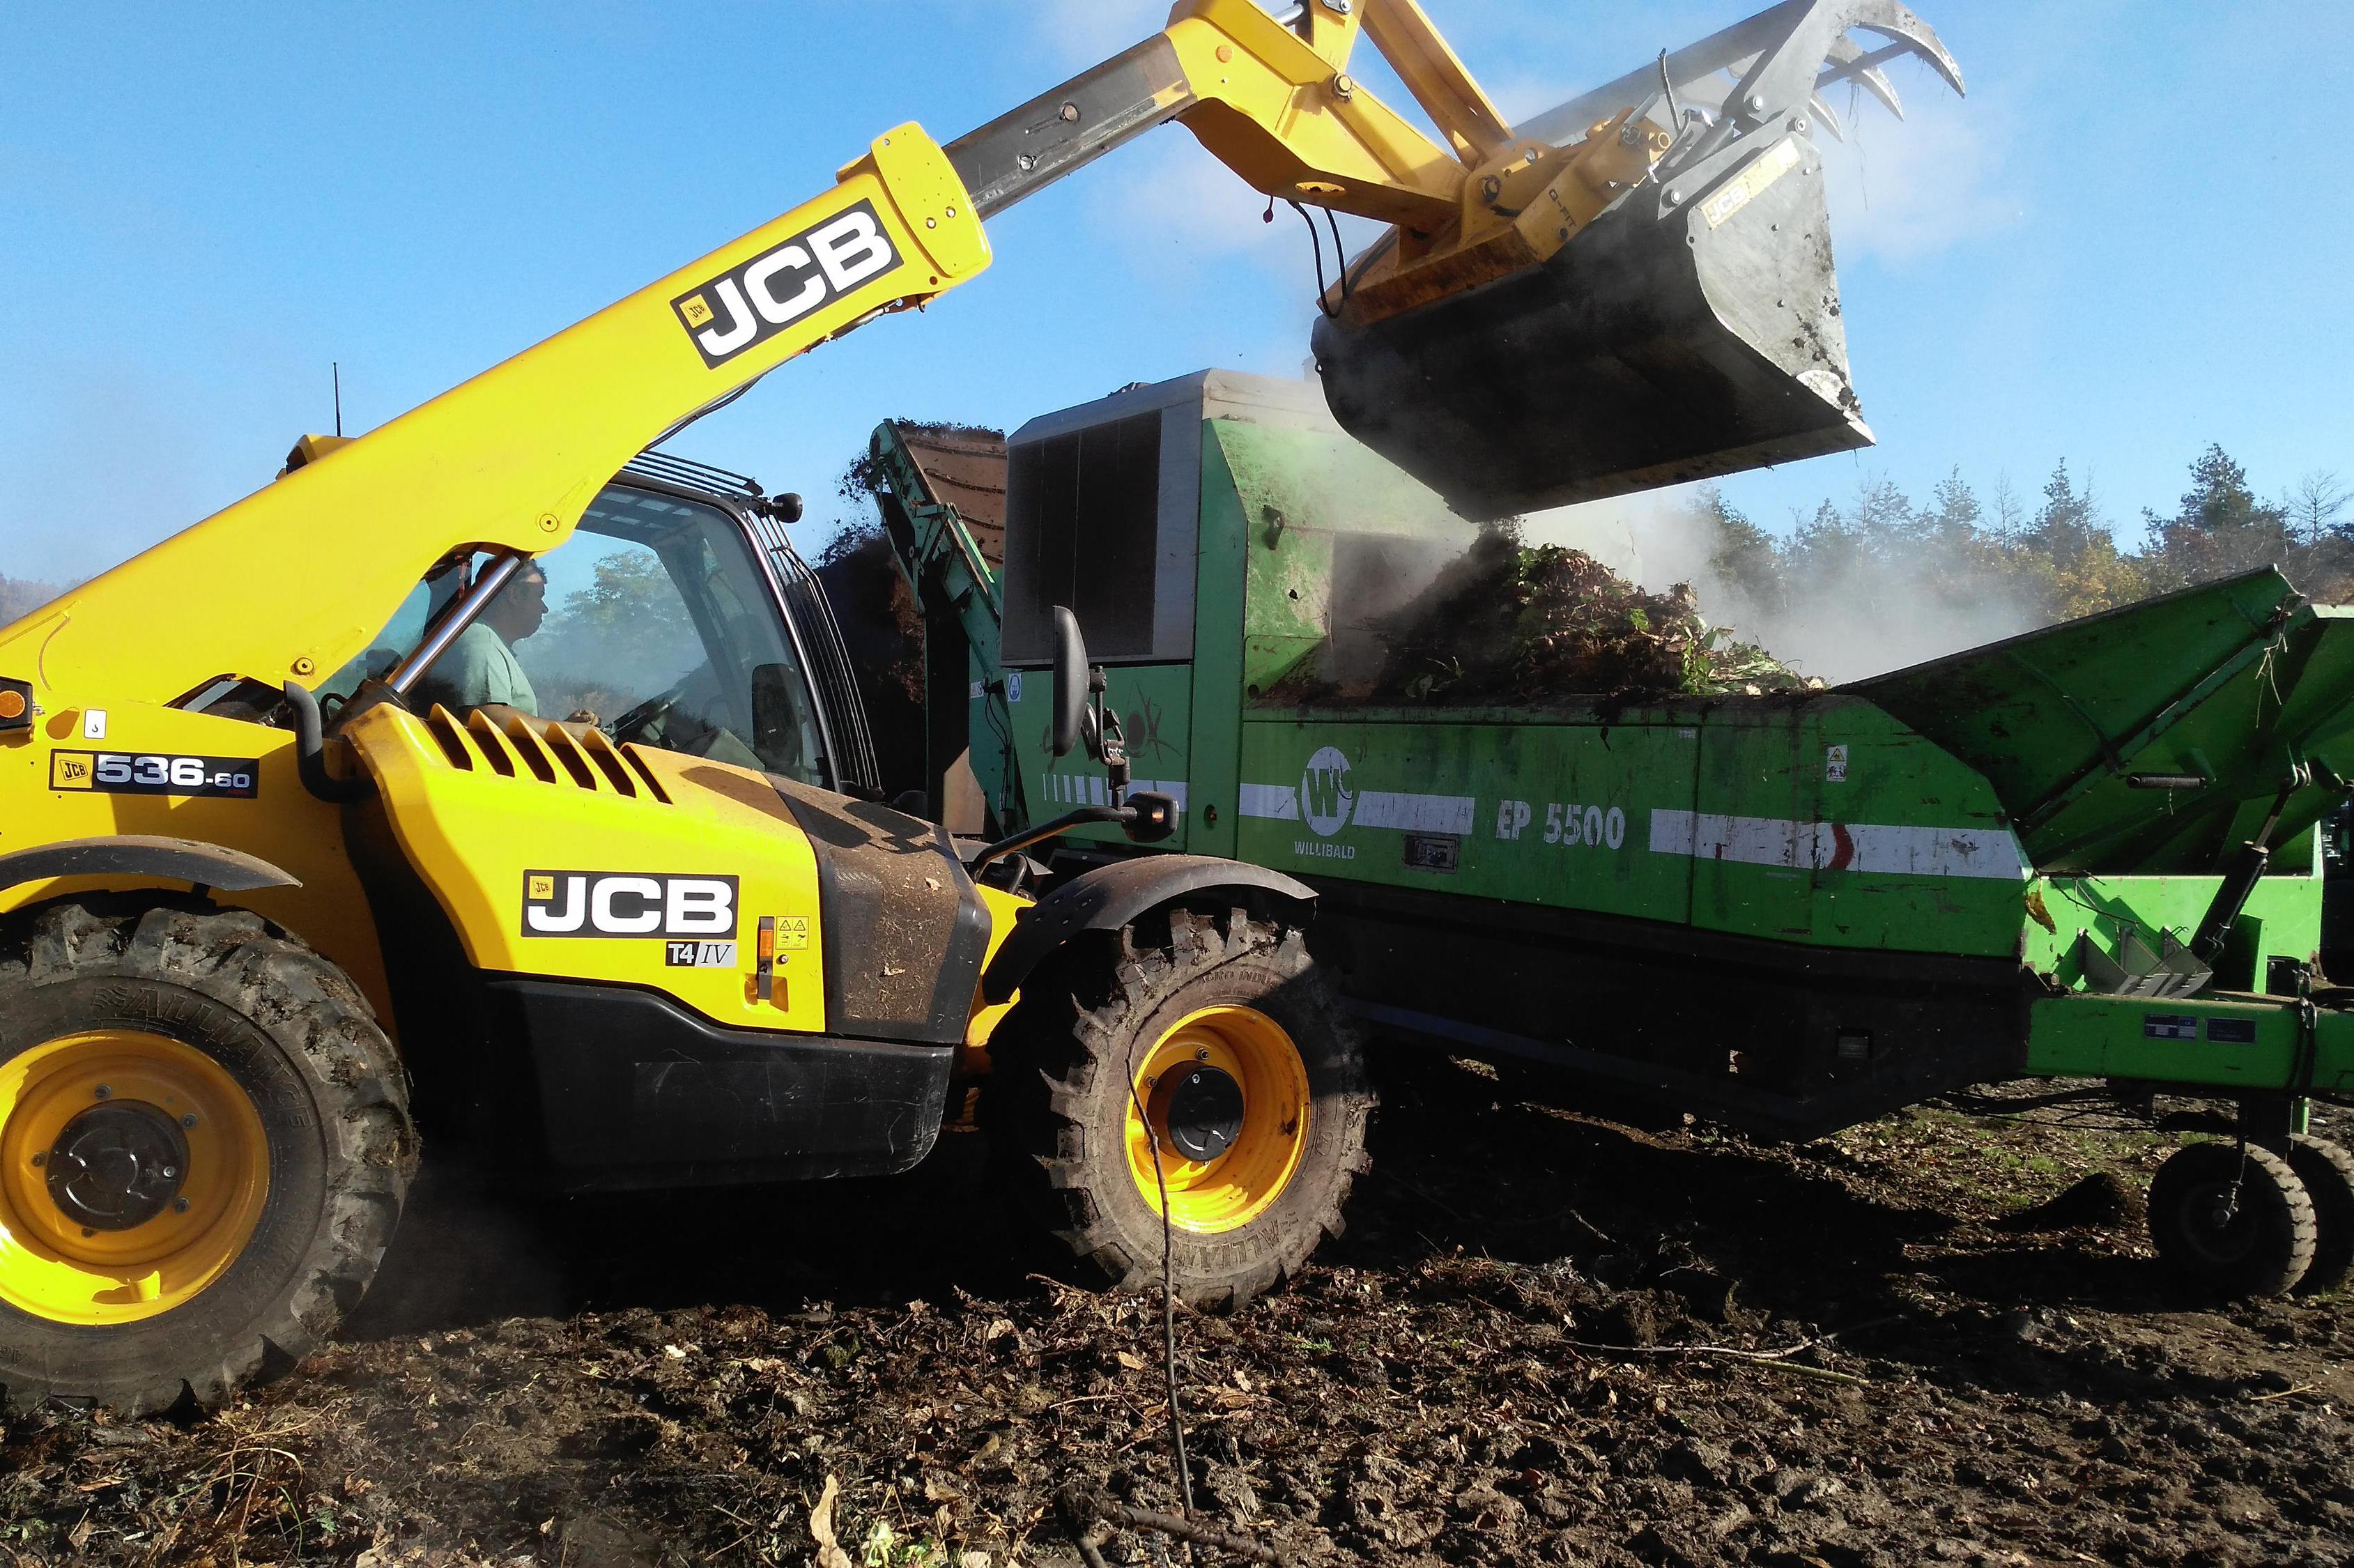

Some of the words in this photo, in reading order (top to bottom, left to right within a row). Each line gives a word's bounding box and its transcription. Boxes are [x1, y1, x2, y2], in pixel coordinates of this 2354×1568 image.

[1709, 185, 1744, 222] JCB
[698, 211, 892, 357] JCB
[688, 305, 705, 318] JCB
[65, 762, 86, 778] JCB
[96, 754, 250, 788] 536-60
[1495, 799, 1531, 840] EP
[1544, 802, 1625, 850] 5500
[1294, 841, 1355, 860] WILLIBALD
[535, 882, 550, 893] JCB
[528, 876, 733, 934] JCB
[668, 943, 695, 964] T4
